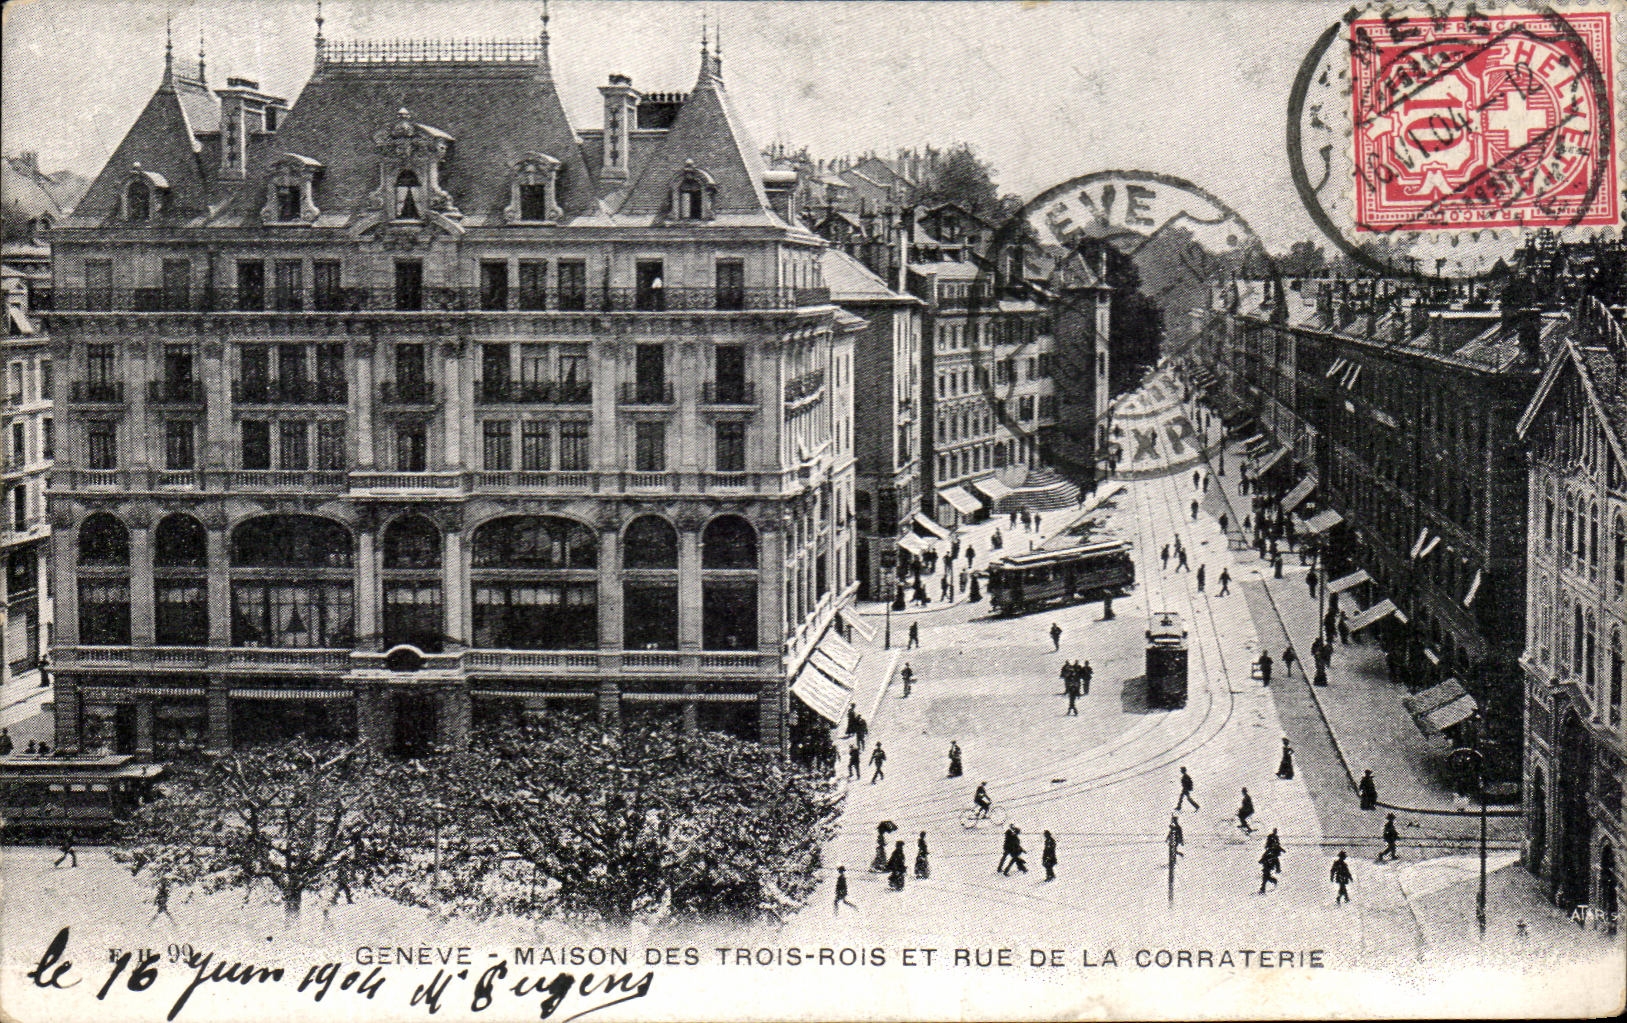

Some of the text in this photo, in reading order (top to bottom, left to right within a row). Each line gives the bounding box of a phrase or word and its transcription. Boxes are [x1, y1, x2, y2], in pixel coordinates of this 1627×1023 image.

[1442, 21, 1522, 34] FRANCO
[1402, 91, 1466, 153] 10
[1511, 40, 1588, 197] HELVETIA
[1449, 209, 1526, 223] FRANCO
[96, 952, 160, 1001] 16
[297, 962, 387, 1002] 1904
